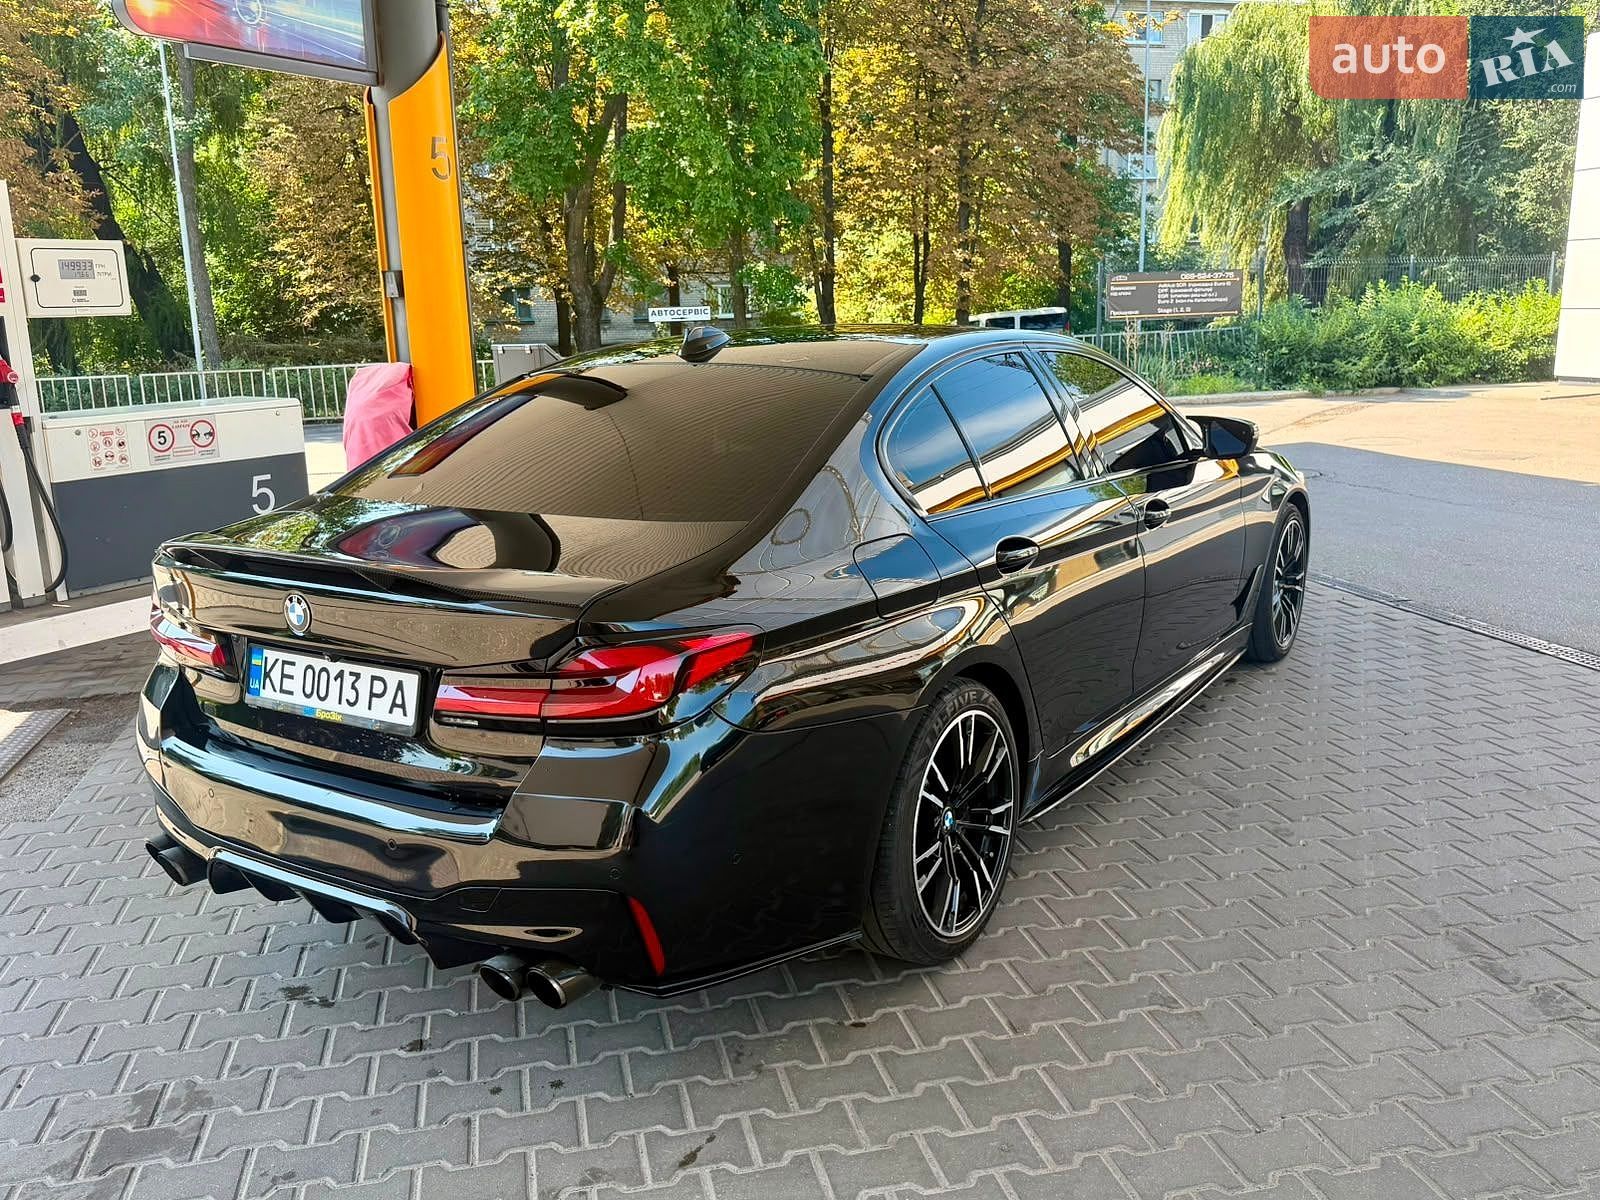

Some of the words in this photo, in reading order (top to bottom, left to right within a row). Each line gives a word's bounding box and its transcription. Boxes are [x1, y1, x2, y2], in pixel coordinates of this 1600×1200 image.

[431, 136, 451, 180] 5
[650, 308, 709, 317] АВТОСЕРВІС
[157, 430, 167, 446] 5
[252, 474, 275, 515] 5
[250, 678, 259, 690] UA
[262, 656, 296, 696] KE
[302, 664, 361, 708] 0013
[368, 674, 408, 717] PA
